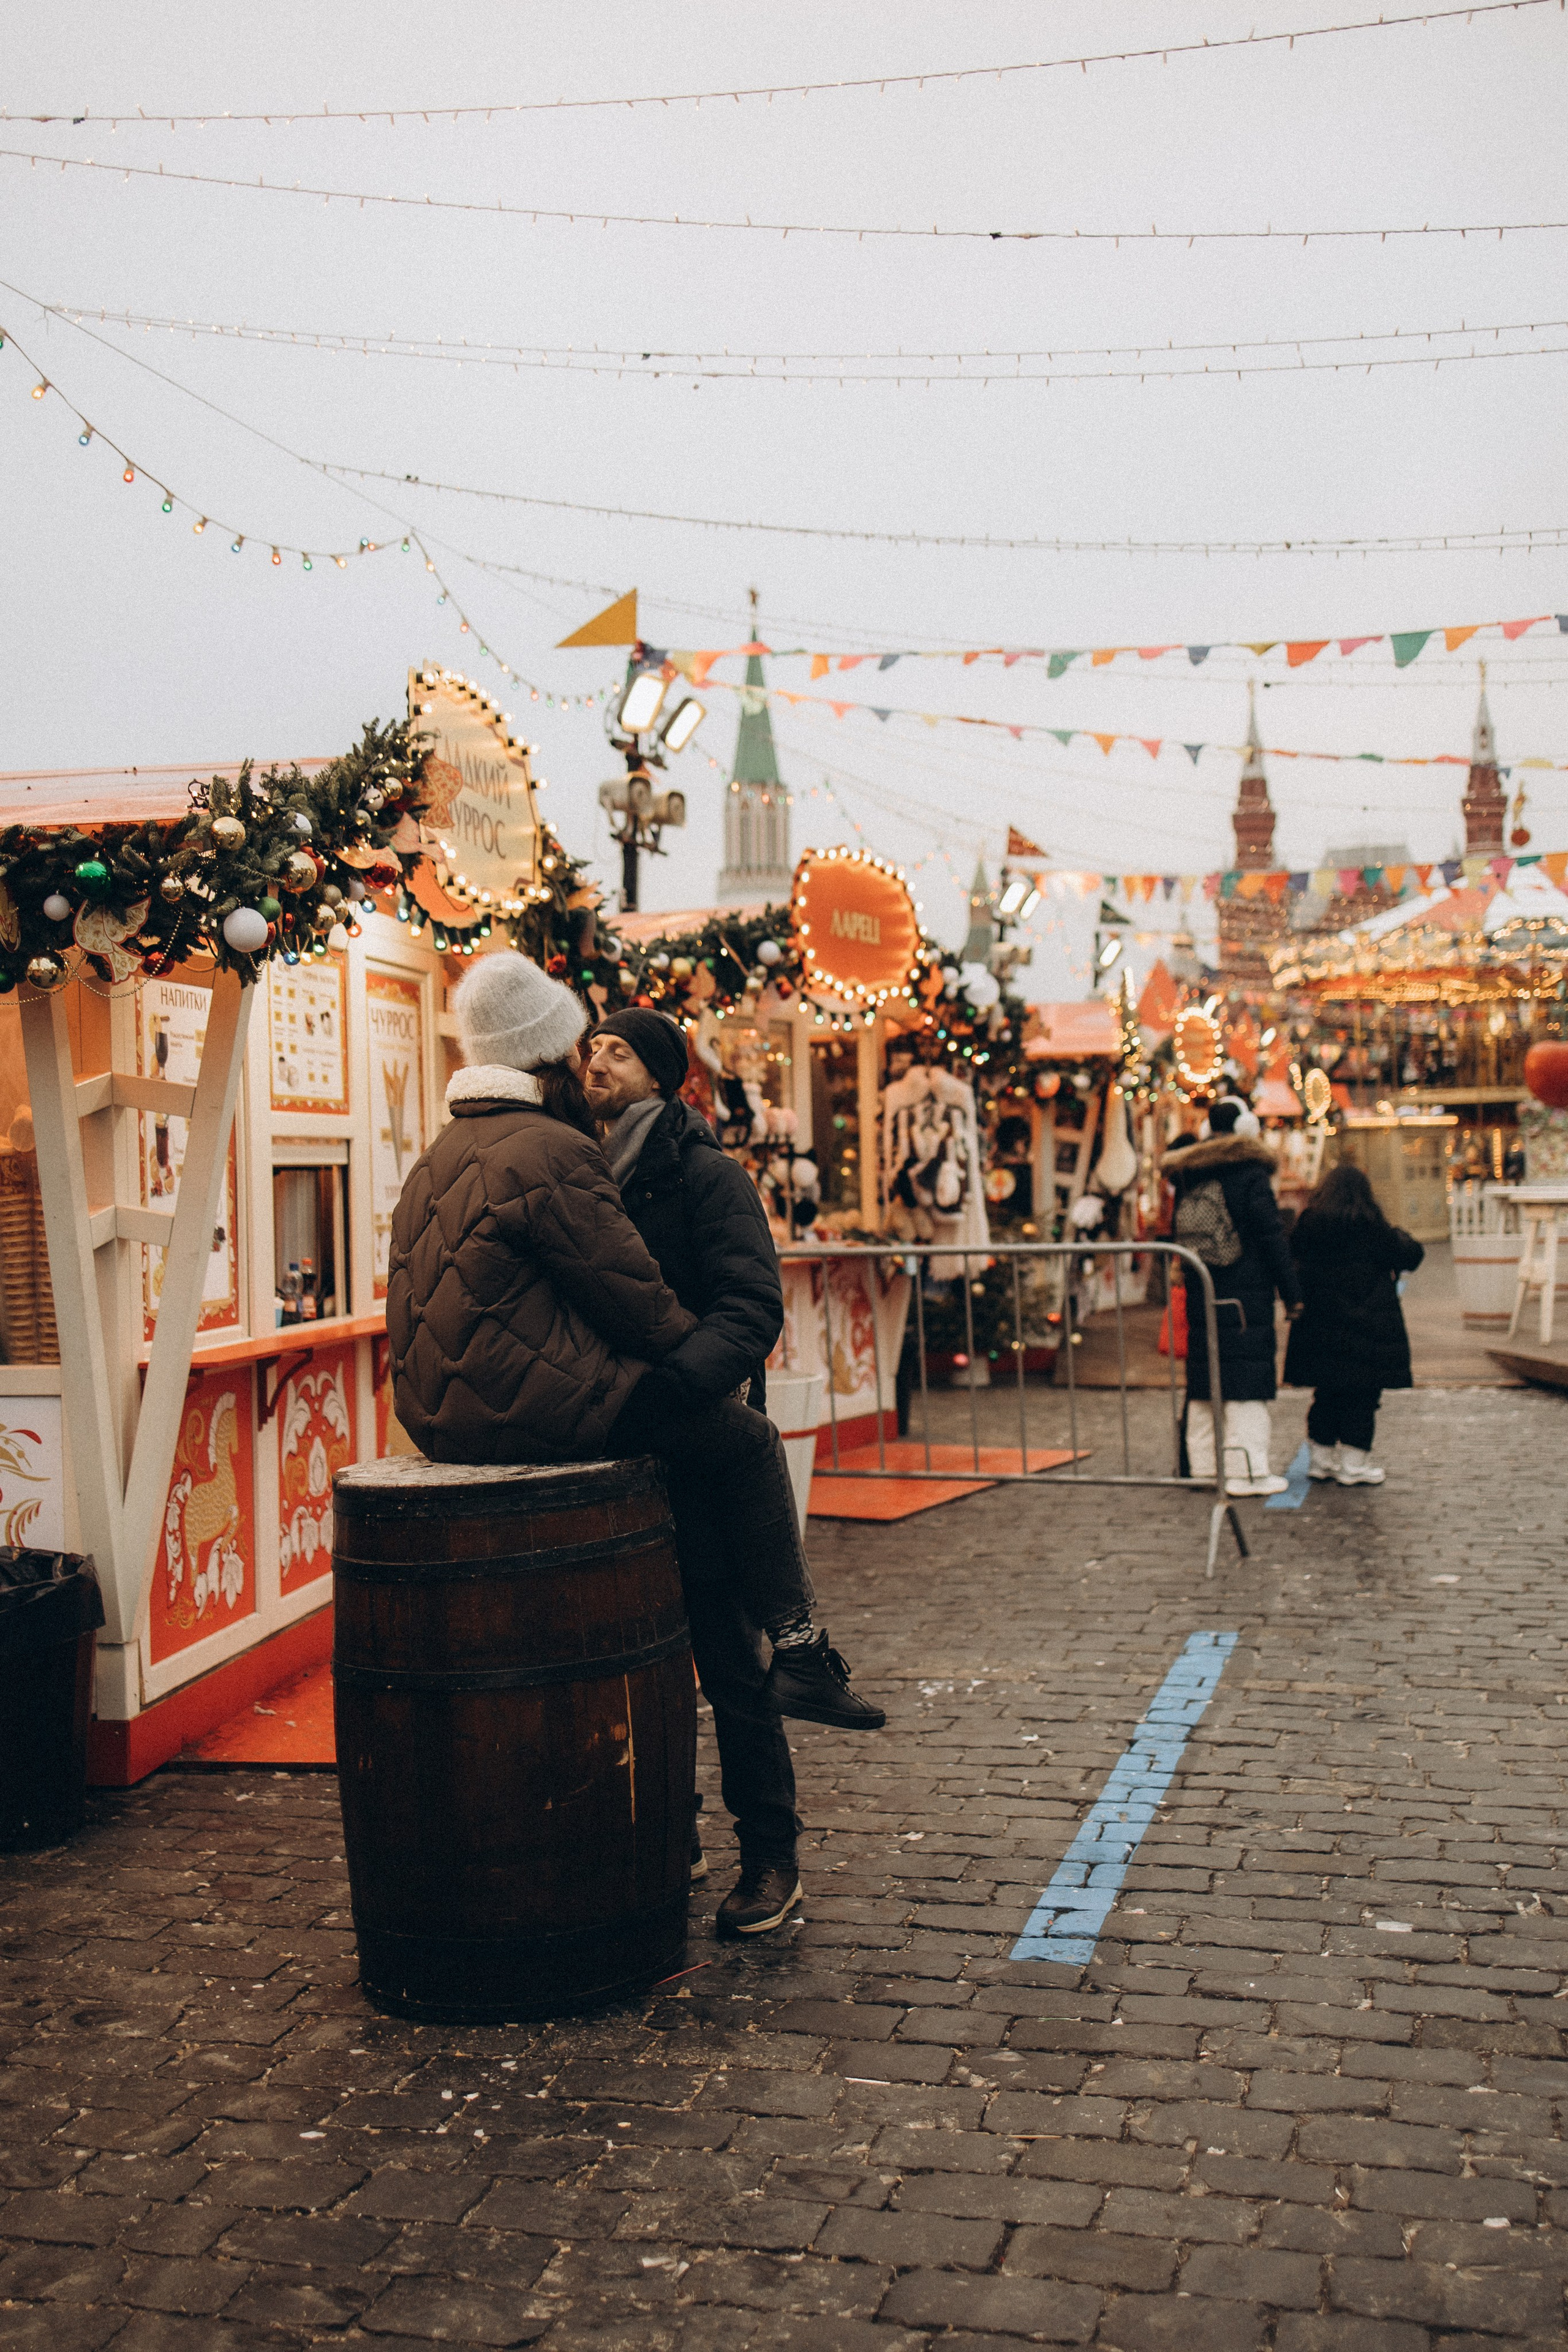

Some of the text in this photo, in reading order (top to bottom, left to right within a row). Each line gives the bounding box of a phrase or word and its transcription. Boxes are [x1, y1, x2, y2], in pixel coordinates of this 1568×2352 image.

[434, 727, 511, 809] ЛАДКИЙ
[160, 986, 207, 1011] НАПИТКИ
[371, 1008, 415, 1040] ЧУРРОС
